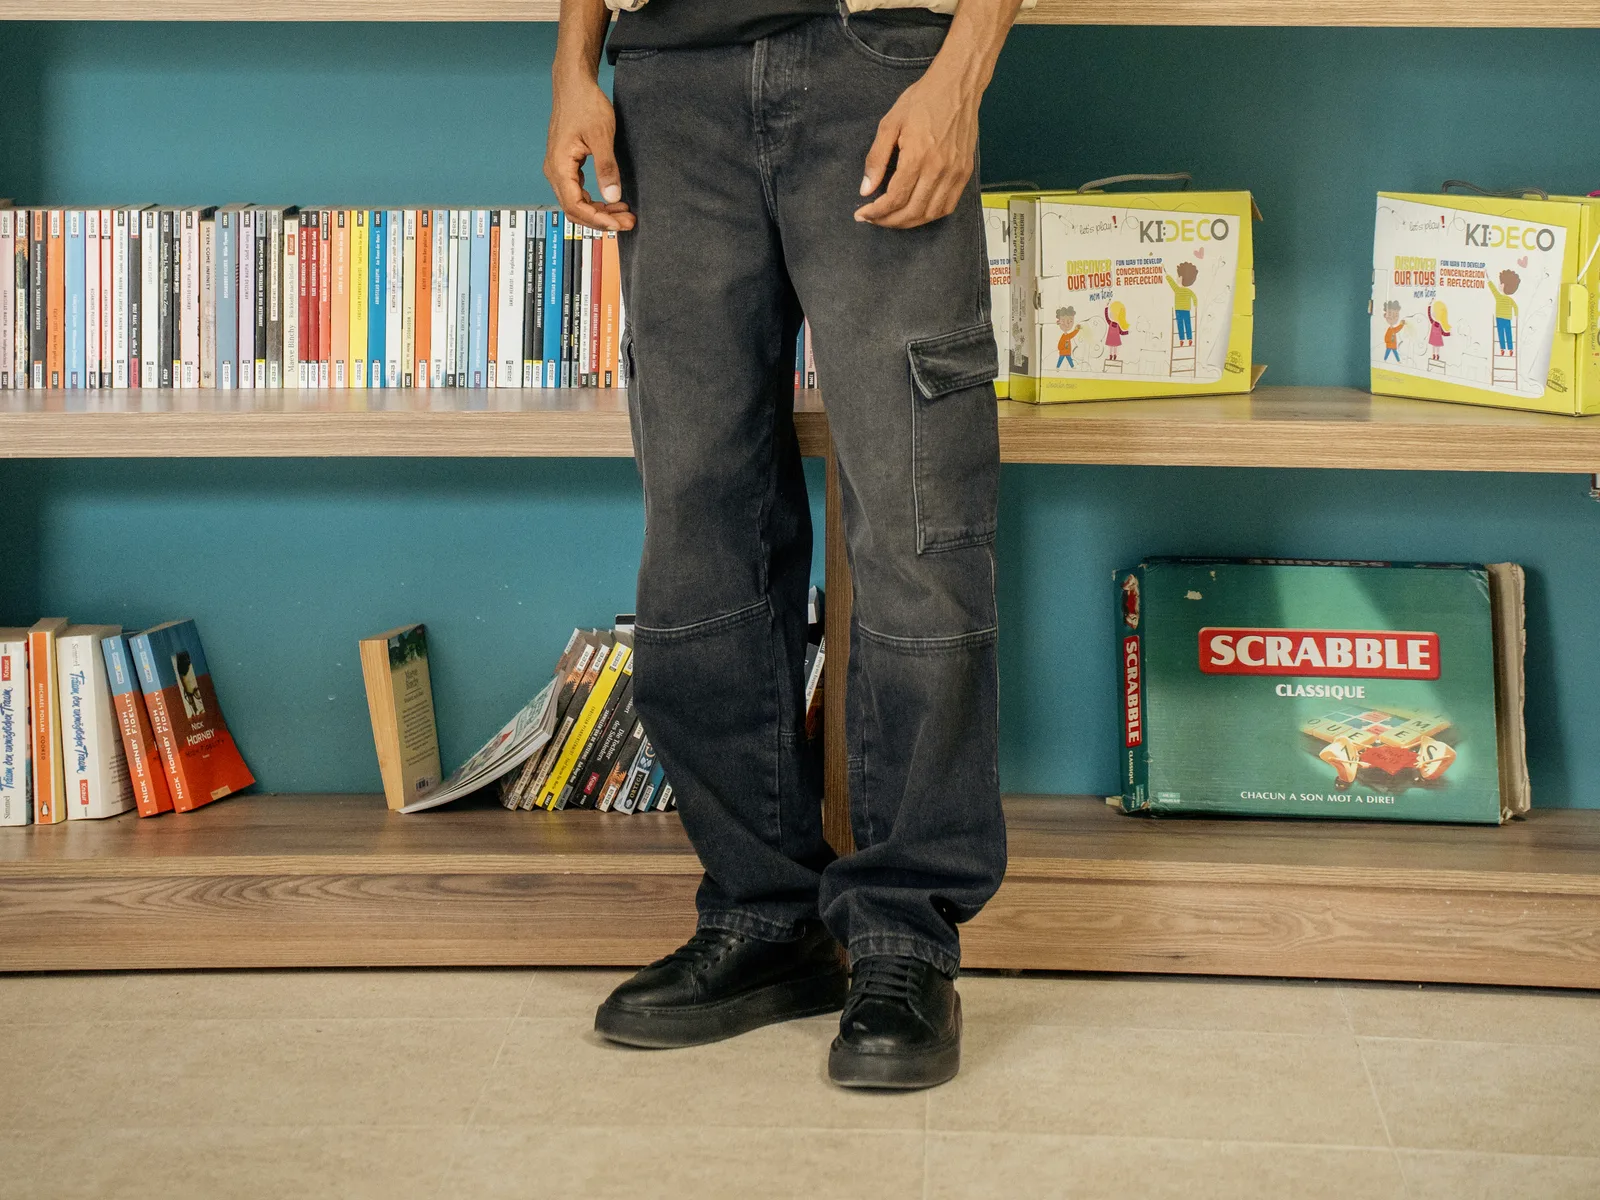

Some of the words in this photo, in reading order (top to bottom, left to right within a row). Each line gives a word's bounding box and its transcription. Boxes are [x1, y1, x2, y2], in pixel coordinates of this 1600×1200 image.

[1067, 259, 1112, 275] DISCOVER
[1395, 255, 1436, 270] DISCOVER
[1068, 275, 1087, 291] OUR
[1088, 272, 1112, 288] TOYS
[1116, 278, 1121, 286] &
[1394, 270, 1412, 285] OUR
[1413, 271, 1435, 286] TOYS
[1440, 278, 1444, 286] &
[287, 324, 297, 349] Binchy
[287, 350, 295, 372] Maeve
[1210, 635, 1431, 671] SCRABBLE
[1126, 641, 1140, 742] SCRABBLE
[1275, 683, 1366, 701] CLASSIQUE
[125, 693, 137, 734] FIDELITY
[153, 709, 162, 733] HIGH
[154, 691, 167, 732] FIDELITY
[122, 711, 130, 736] HIGH
[191, 721, 204, 731] NICK
[186, 728, 215, 747] HORNBY
[131, 738, 144, 777] HORNBY
[162, 736, 177, 773] HORNBY
[607, 738, 620, 760] Tochter
[138, 780, 149, 803] NICK
[172, 777, 183, 800] NICK
[587, 776, 597, 791] Knaur
[1240, 790, 1286, 801] CHACUN
[1289, 792, 1297, 802] A
[1300, 792, 1324, 803] SON
[1327, 793, 1352, 803] MOT
[1355, 795, 1364, 804] A
[1365, 794, 1395, 805] DIRE!
